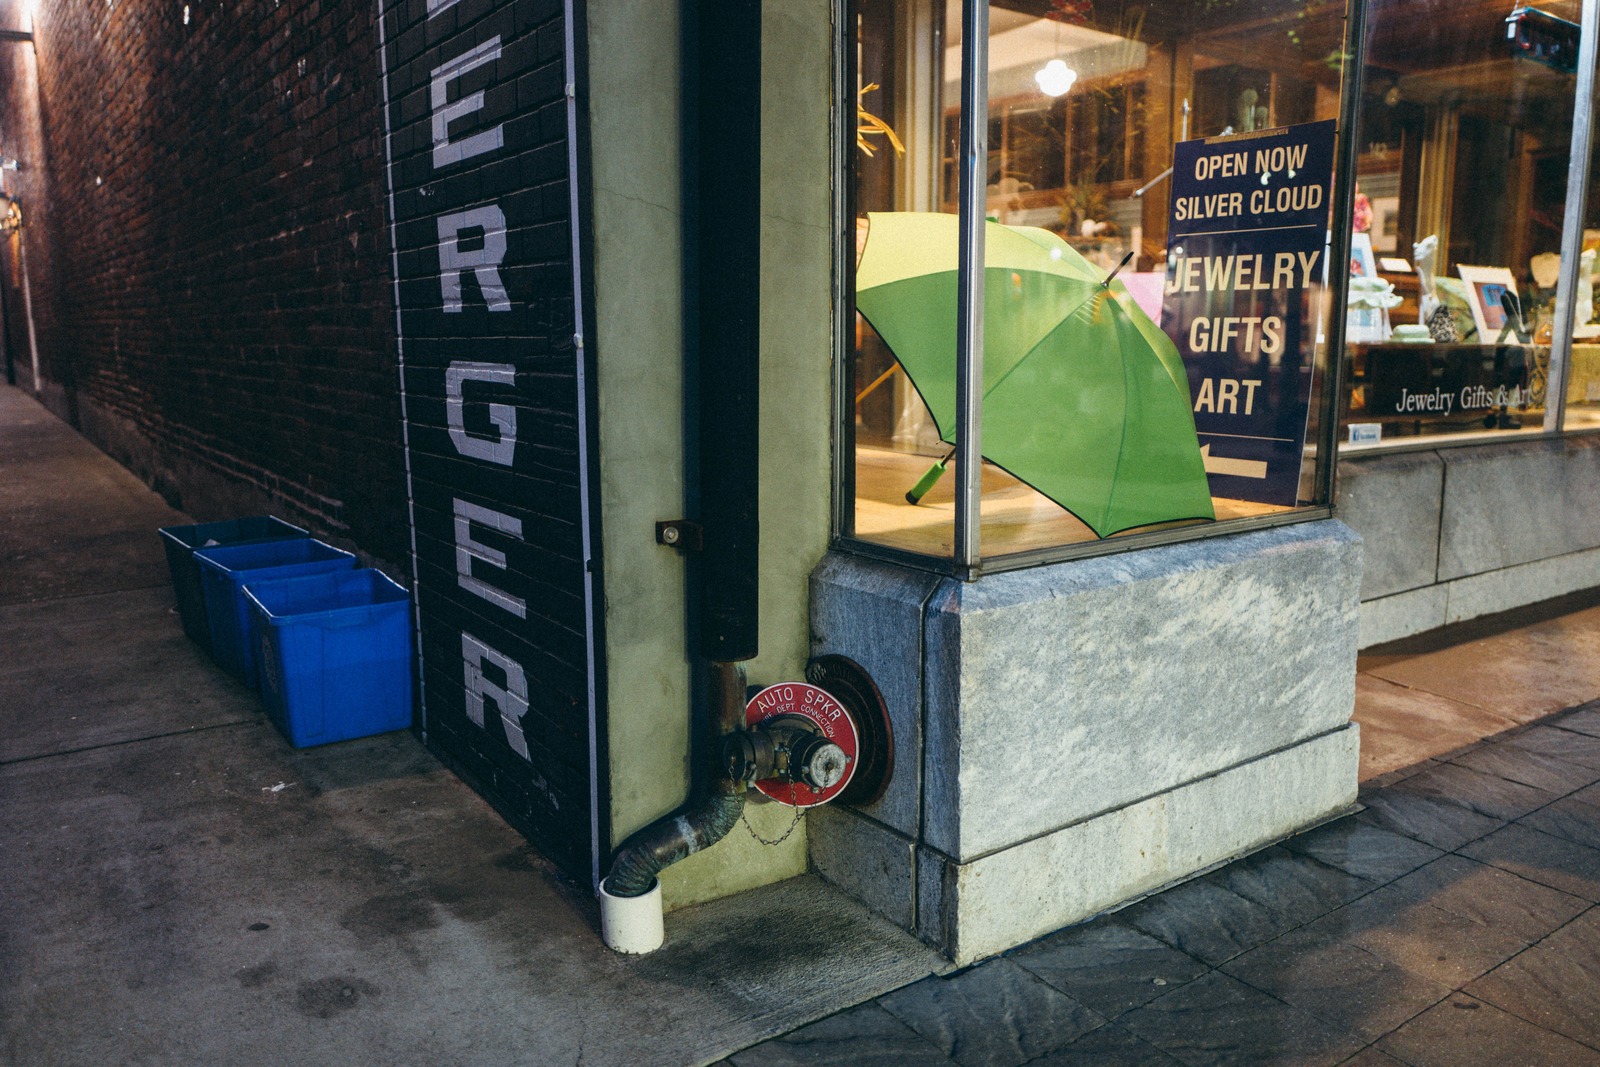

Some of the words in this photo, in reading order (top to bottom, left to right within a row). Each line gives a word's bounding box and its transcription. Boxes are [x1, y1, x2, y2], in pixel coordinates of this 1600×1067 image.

[1195, 152, 1248, 181] OPEN
[1255, 144, 1308, 174] NOW
[1175, 192, 1243, 221] SILVER
[1250, 184, 1323, 215] CLOUD
[1166, 251, 1320, 293] JEWELRY
[1189, 316, 1281, 354] GIFTS
[426, 0, 531, 763] ERGER
[1194, 377, 1262, 415] ART
[1396, 387, 1455, 416] Jewelry
[1460, 385, 1494, 409] Gifts
[1497, 384, 1508, 407] &
[1511, 383, 1532, 406] Art
[757, 687, 793, 713] AUTO
[804, 690, 841, 721] SPKR
[776, 703, 797, 713] DEPT.
[800, 704, 835, 738] CONNECTION
